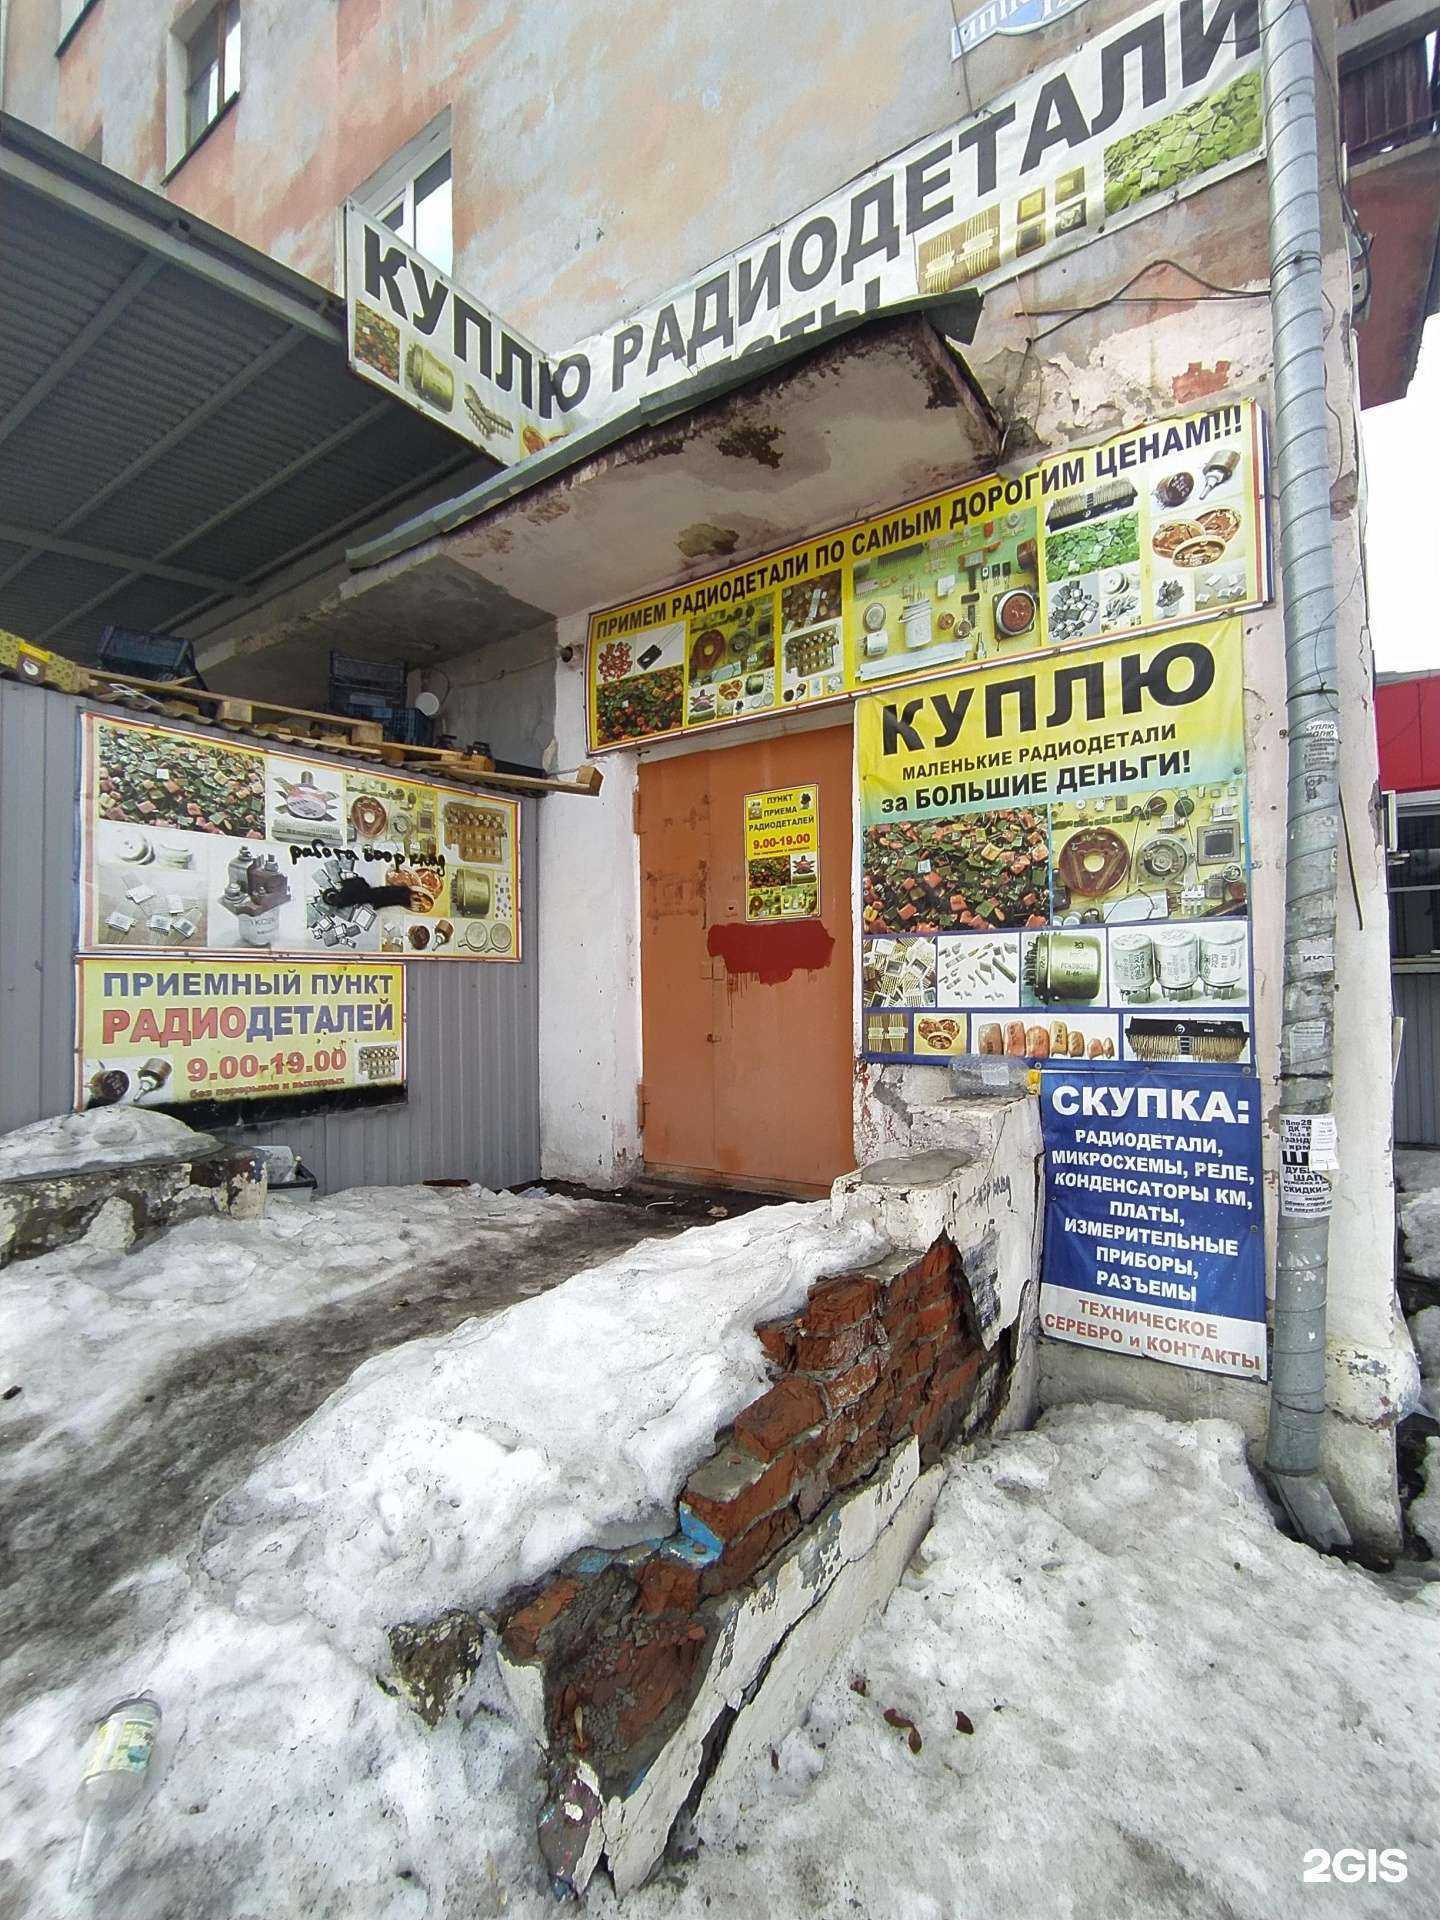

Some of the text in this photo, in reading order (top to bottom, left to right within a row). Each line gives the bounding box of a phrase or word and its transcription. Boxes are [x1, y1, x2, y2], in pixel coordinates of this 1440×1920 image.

[364, 0, 1260, 420] КУПЛЮ РАДИОДЕТАЛИ
[597, 406, 1242, 640] ПРИМЕМ РАДИОДЕТАЛИ ПО САМЫМ ДОРОГИМ ЦЕНАМ!!!
[882, 642, 1216, 756] КУПЛЮ
[902, 723, 1177, 782] МАЛЕНЬКИЕ РАДИОДЕТАЛИ
[767, 794, 792, 804] ПУНКТ
[881, 749, 1191, 814] за БОЛЬШИЕ ДЕНЬГИ!
[749, 815, 814, 831] РАДИОДЕТАЛЕЙ
[764, 806, 797, 816] ПРИЕМА
[753, 833, 811, 850] 9.00-19.00
[103, 969, 393, 997] ПРИЕМНЫЙ ПУНКТ
[102, 998, 393, 1048] РАДИОДЕТАЛЕЙ
[186, 1049, 348, 1083] 9.00-19.00
[1051, 1085, 1250, 1124] СКУПКА:
[1075, 1129, 1224, 1158] РАДИОДЕТАЛИ,
[1051, 1150, 1255, 1186] МИКРОСХЕМЫ, РЕЛЕ,
[1054, 1172, 1253, 1210] КОНДЕНСАТОРЫ КМ,
[1110, 1201, 1185, 1227] ПЛАТЫ,
[1064, 1217, 1239, 1257] ИЗМЕРИТЕЛЬНЫЕ
[1096, 1246, 1199, 1280] ПРИБОРЫ,
[1096, 1270, 1197, 1302] РАЗЪЕМЫ
[1078, 1299, 1219, 1339] ТЕХНИЧЕСКОЕ
[1044, 1313, 1261, 1370] СЕРЕБРО и КОНТАКТЫ
